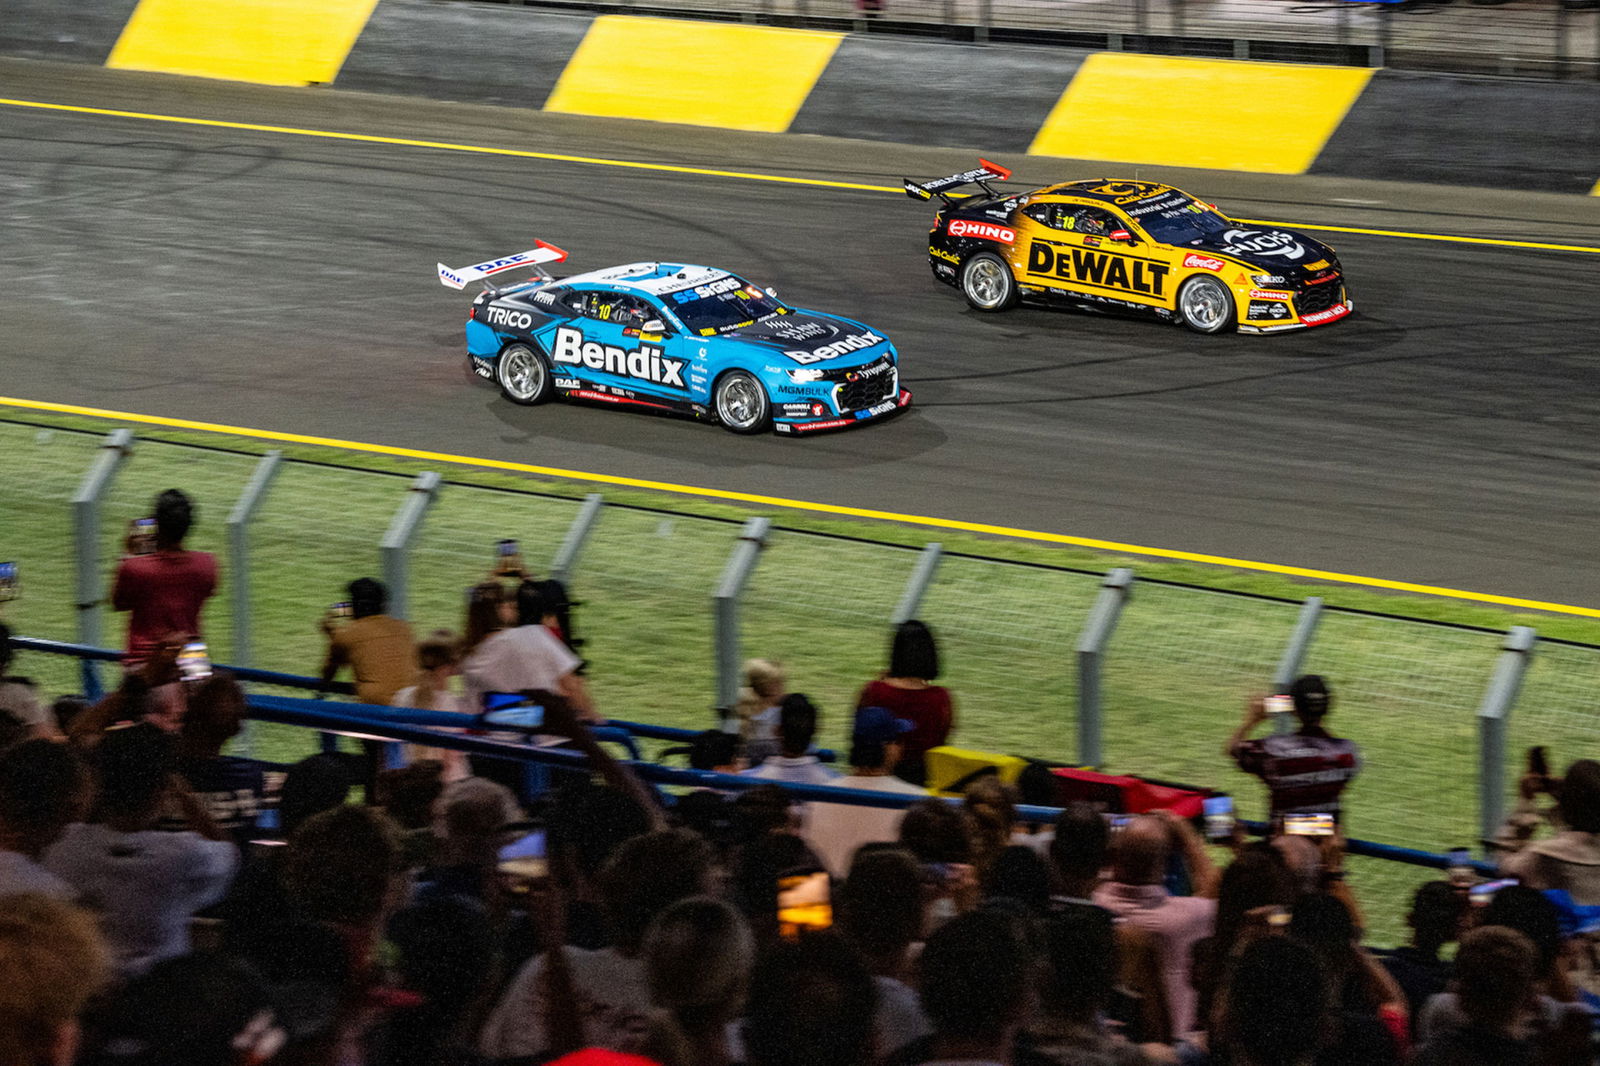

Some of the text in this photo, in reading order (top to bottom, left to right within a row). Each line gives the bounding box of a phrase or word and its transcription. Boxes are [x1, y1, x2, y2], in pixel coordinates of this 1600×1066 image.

[1062, 216, 1075, 230] 18
[966, 224, 1015, 242] HINO
[1220, 230, 1294, 256] FUCHS
[473, 254, 528, 272] DAF
[441, 269, 464, 283] DAF
[1260, 291, 1288, 300] HINO
[486, 306, 533, 329] TRICO
[599, 303, 611, 320] 10
[783, 330, 884, 365] Bendix
[553, 327, 685, 387] Bendix
